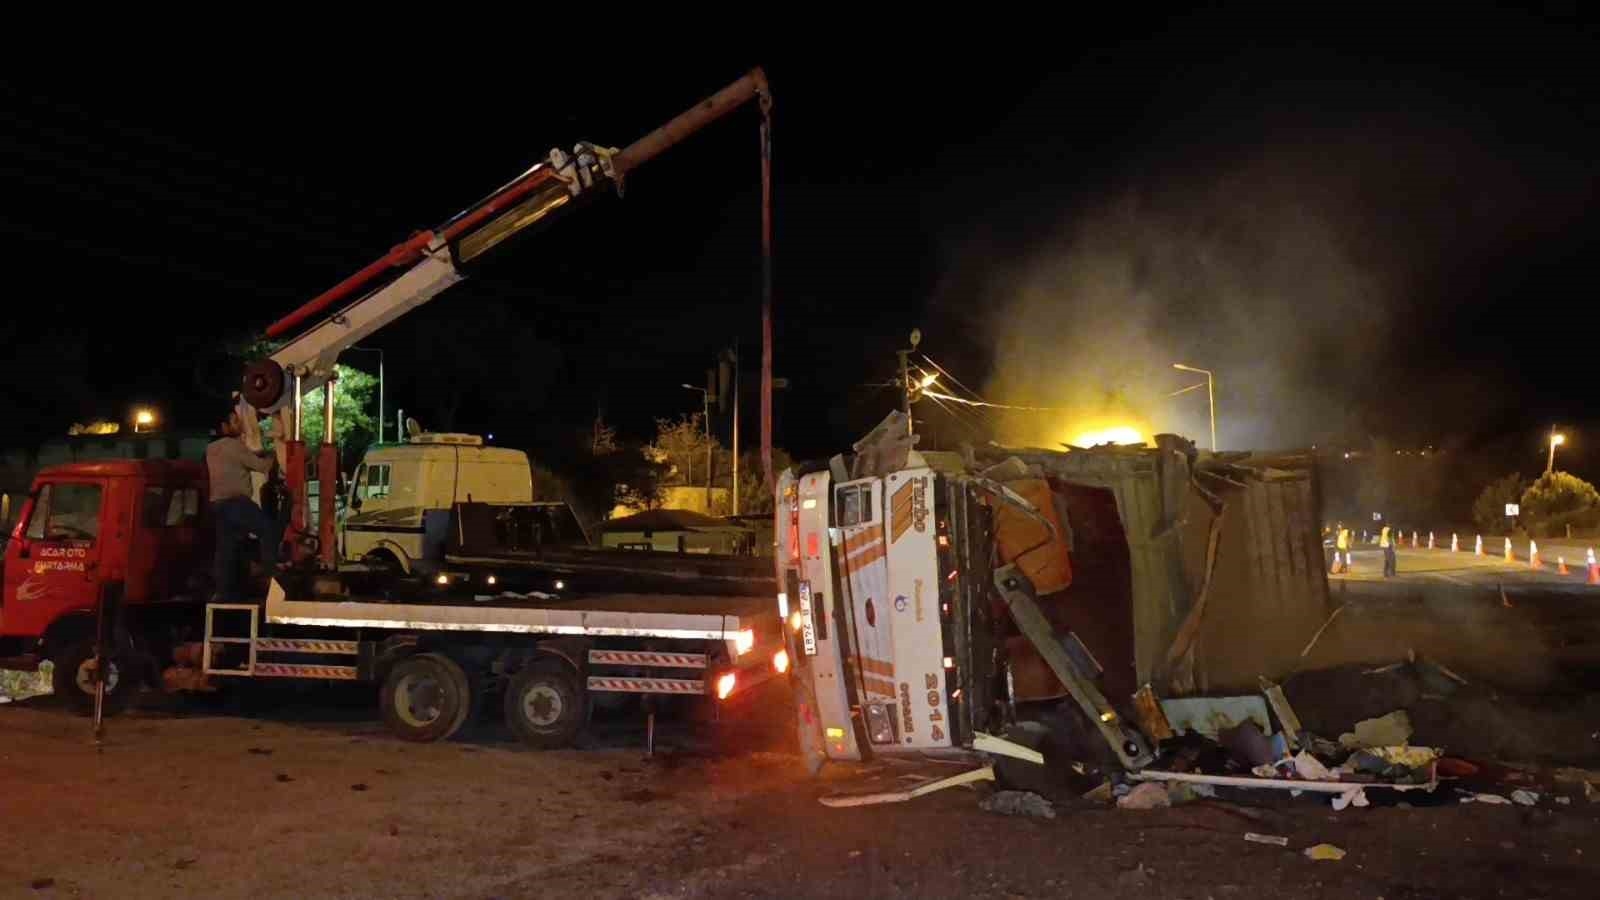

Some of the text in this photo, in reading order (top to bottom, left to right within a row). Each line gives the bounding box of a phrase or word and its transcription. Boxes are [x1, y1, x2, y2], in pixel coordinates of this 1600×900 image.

[913, 476, 929, 532] Turbo
[66, 547, 87, 558] OTO
[925, 671, 945, 741] 2014
